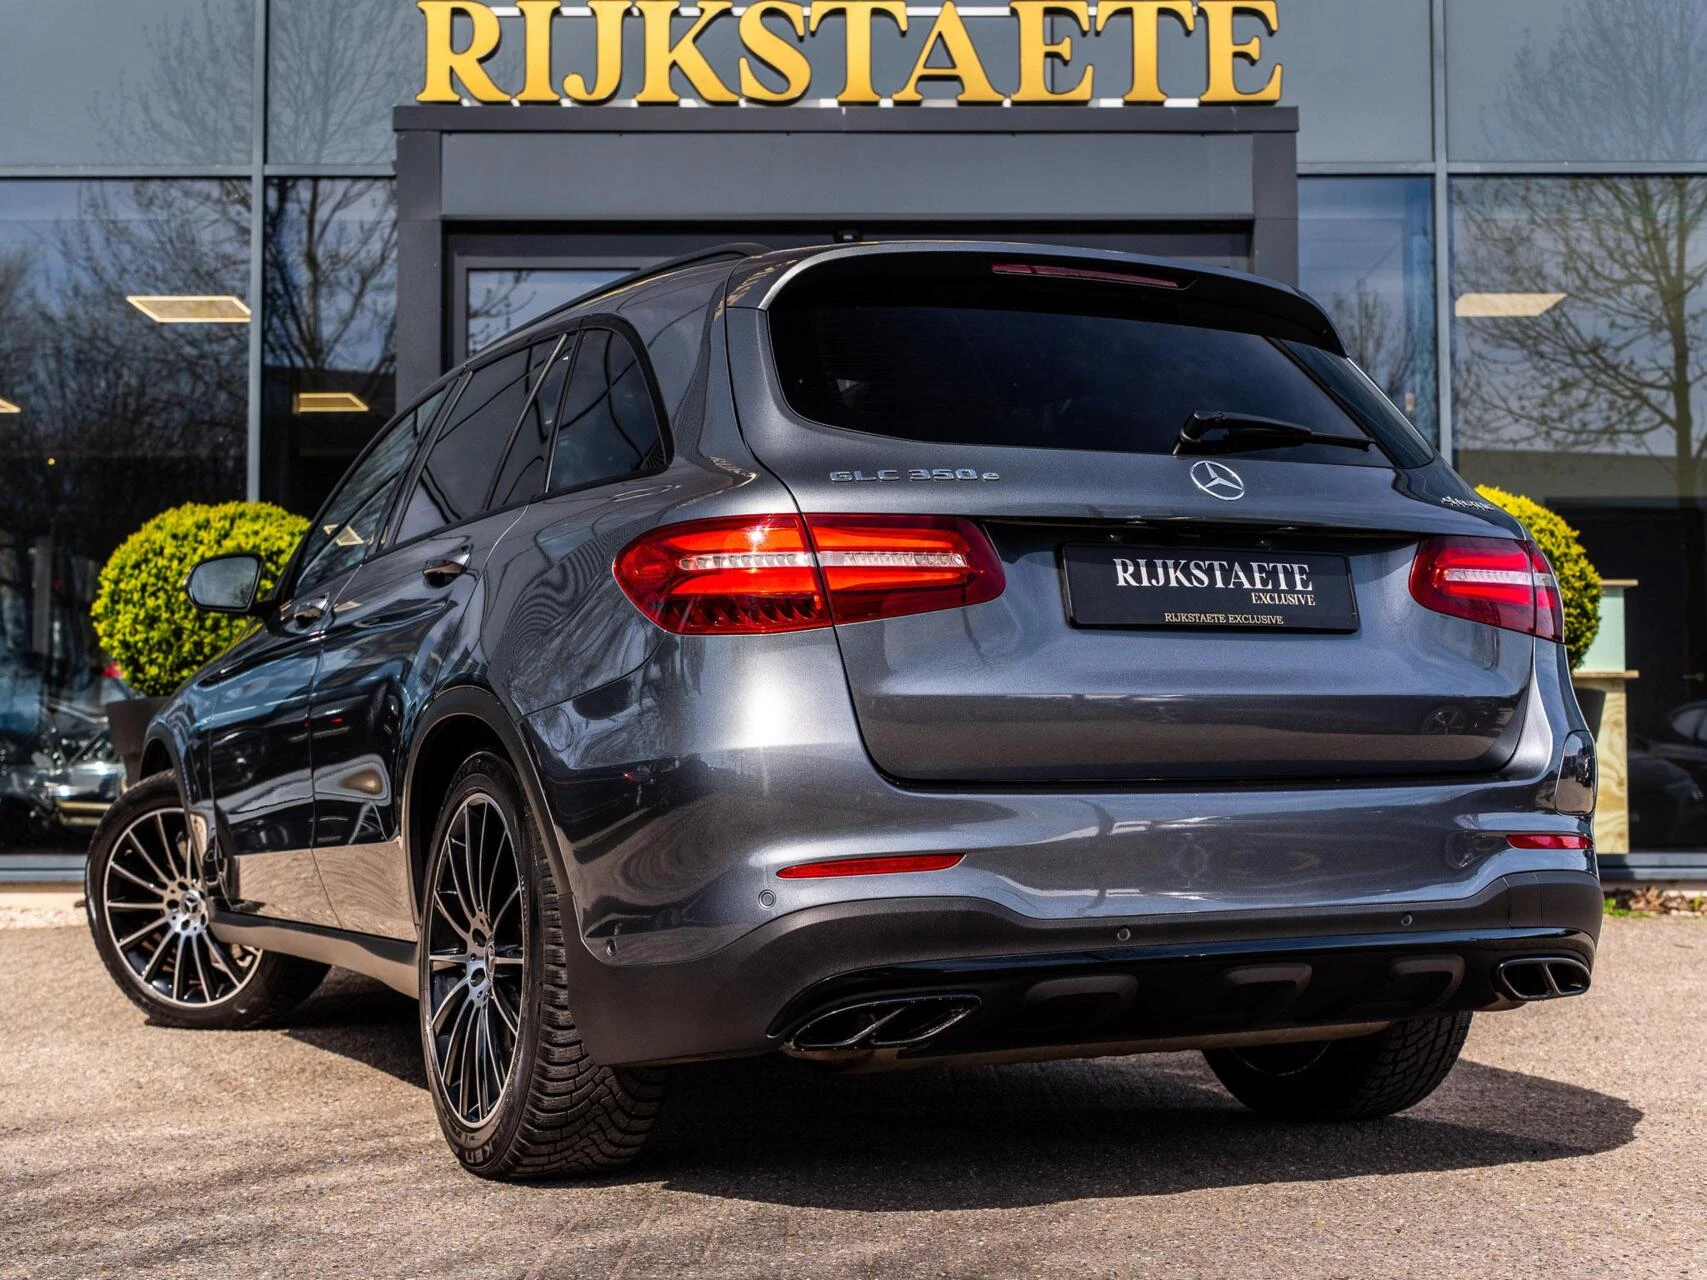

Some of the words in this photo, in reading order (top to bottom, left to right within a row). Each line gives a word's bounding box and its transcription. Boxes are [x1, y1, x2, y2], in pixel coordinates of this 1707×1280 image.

[415, 0, 1284, 106] RIJKSTAETE
[829, 470, 900, 482] GLC
[1113, 558, 1312, 591] RIJKSTAETE
[1251, 591, 1316, 607] EXCLUSIVE
[1164, 612, 1227, 624] RIJKSTAETE
[1228, 613, 1285, 625] EXCLUSIVE
